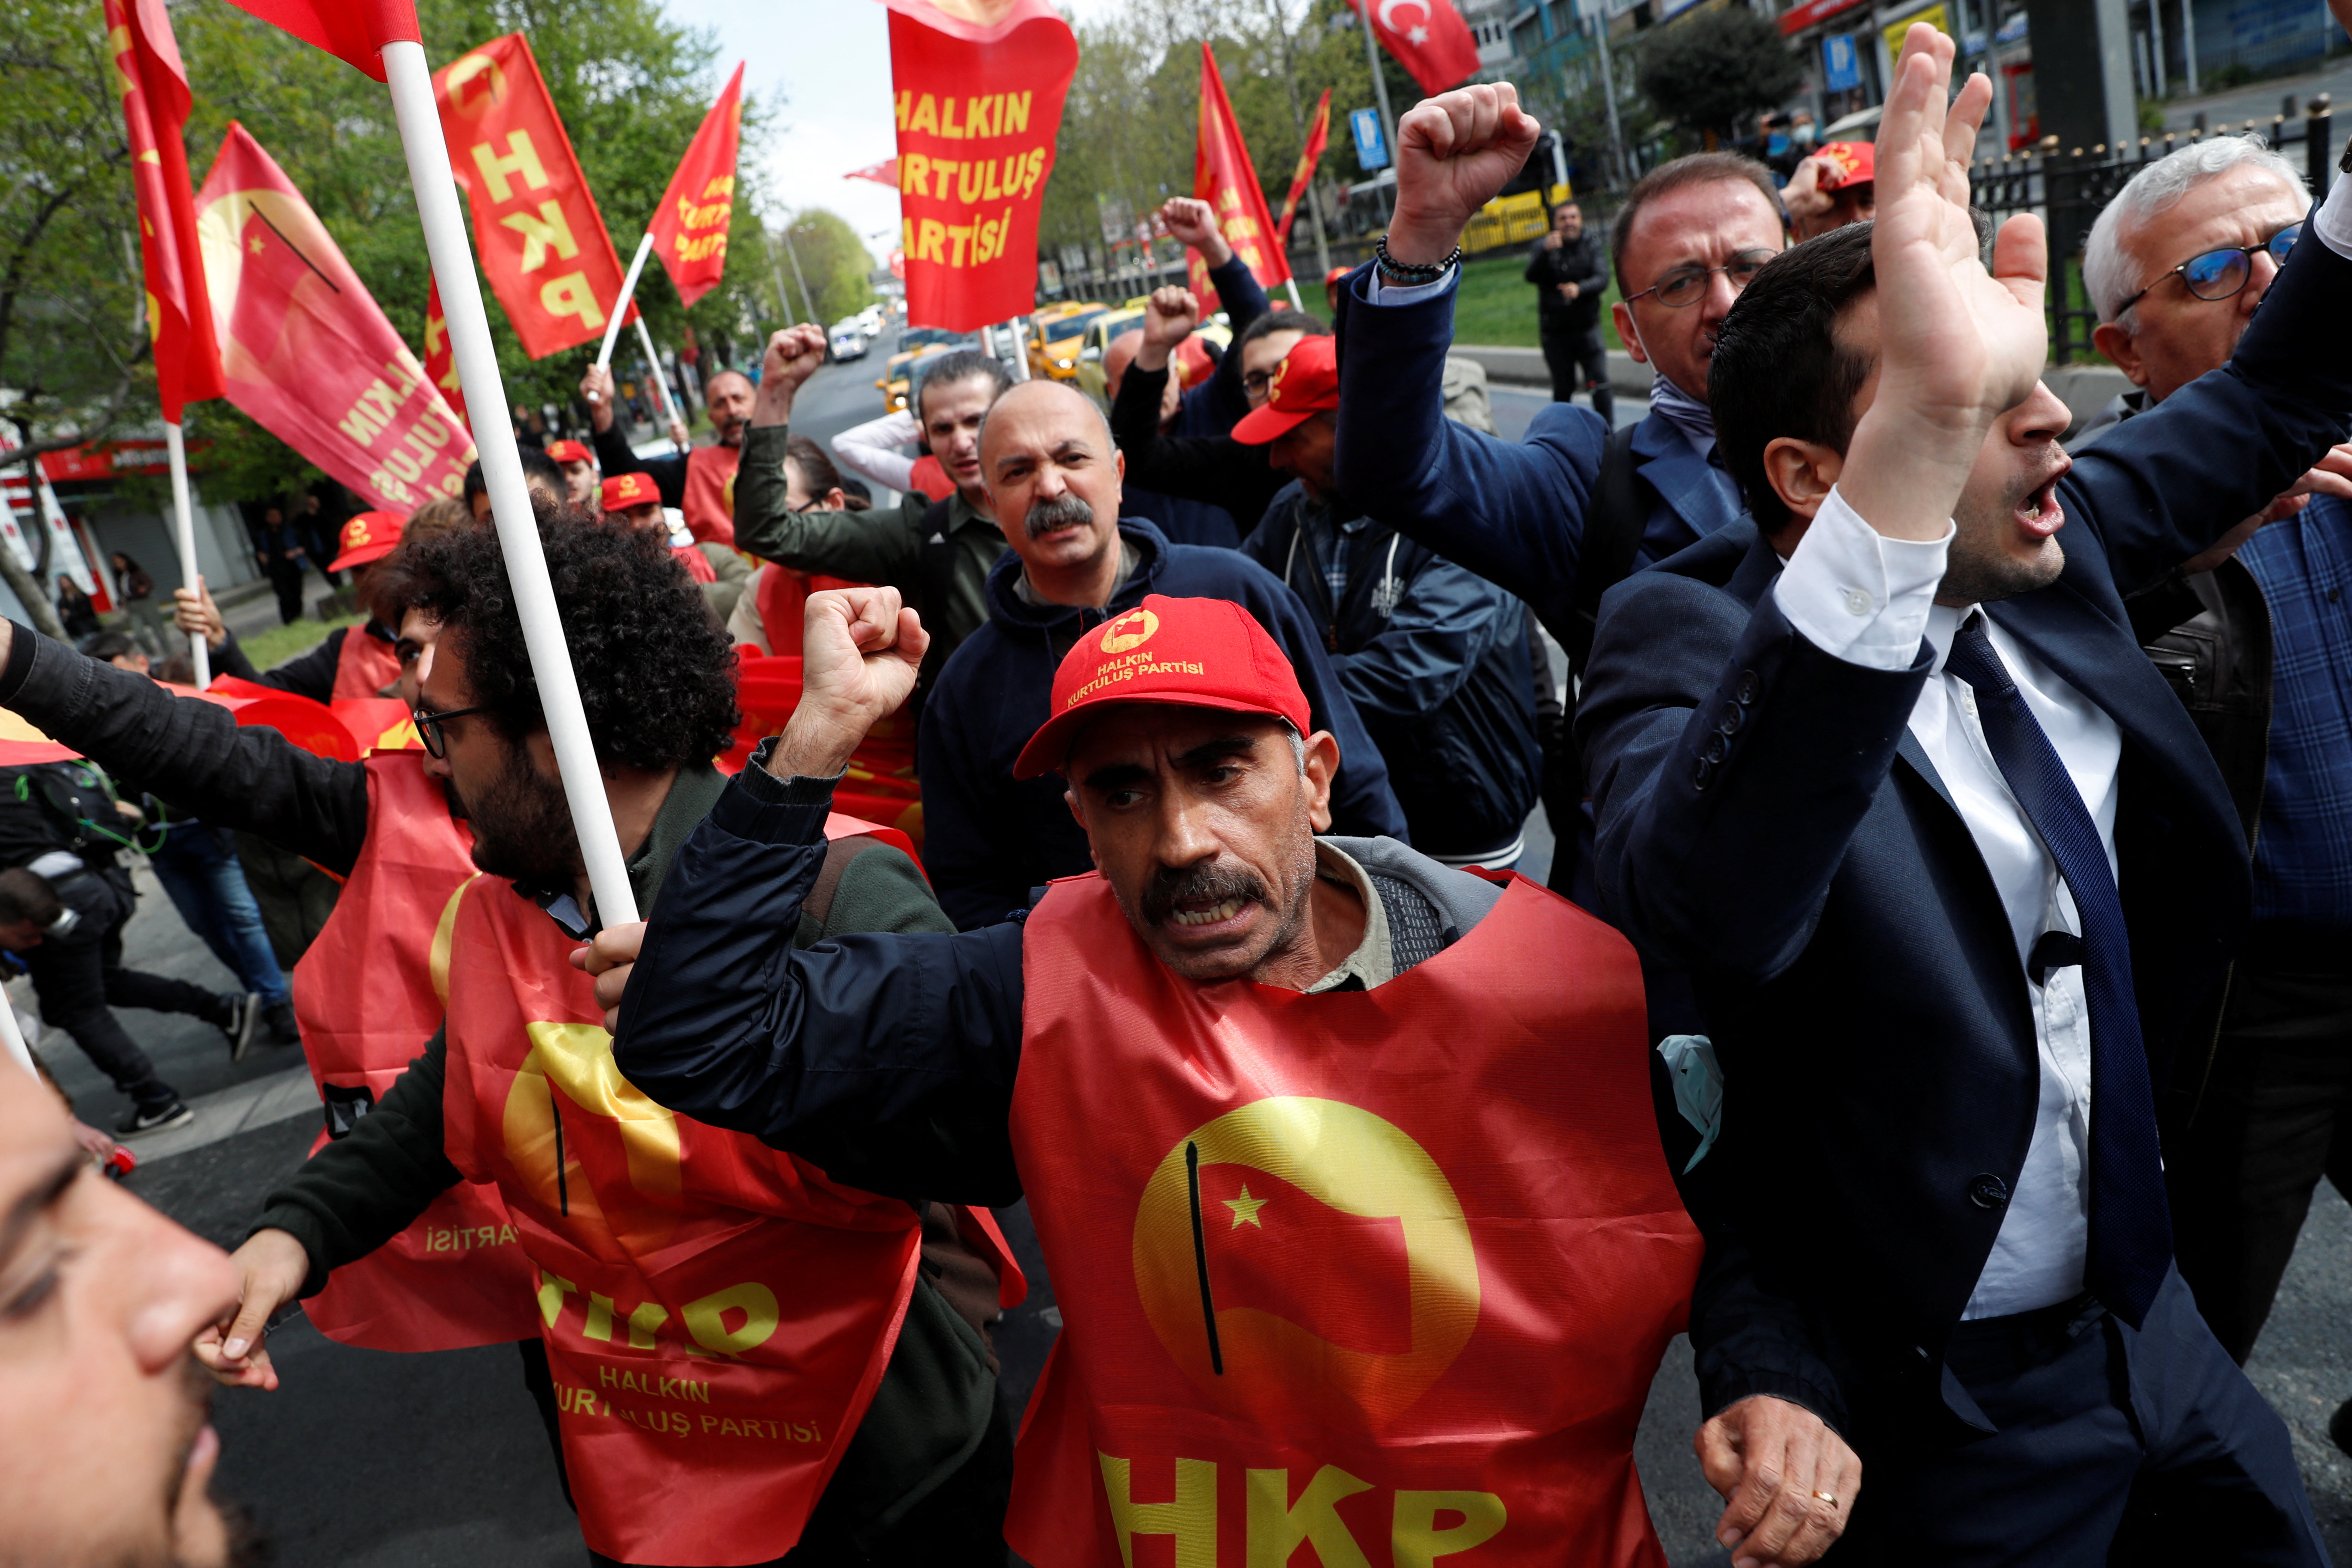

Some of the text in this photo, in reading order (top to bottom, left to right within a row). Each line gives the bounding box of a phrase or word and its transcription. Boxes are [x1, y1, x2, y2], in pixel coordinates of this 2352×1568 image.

[897, 146, 1046, 205] RTULUŞ
[902, 206, 1012, 269] ARTİSİ
[1067, 660, 1204, 709] KURTULUŞ PARTİSİ
[1097, 651, 1153, 677] HALKIN
[599, 1365, 710, 1404] HALKIN
[1097, 1448, 1507, 1568] HKP
